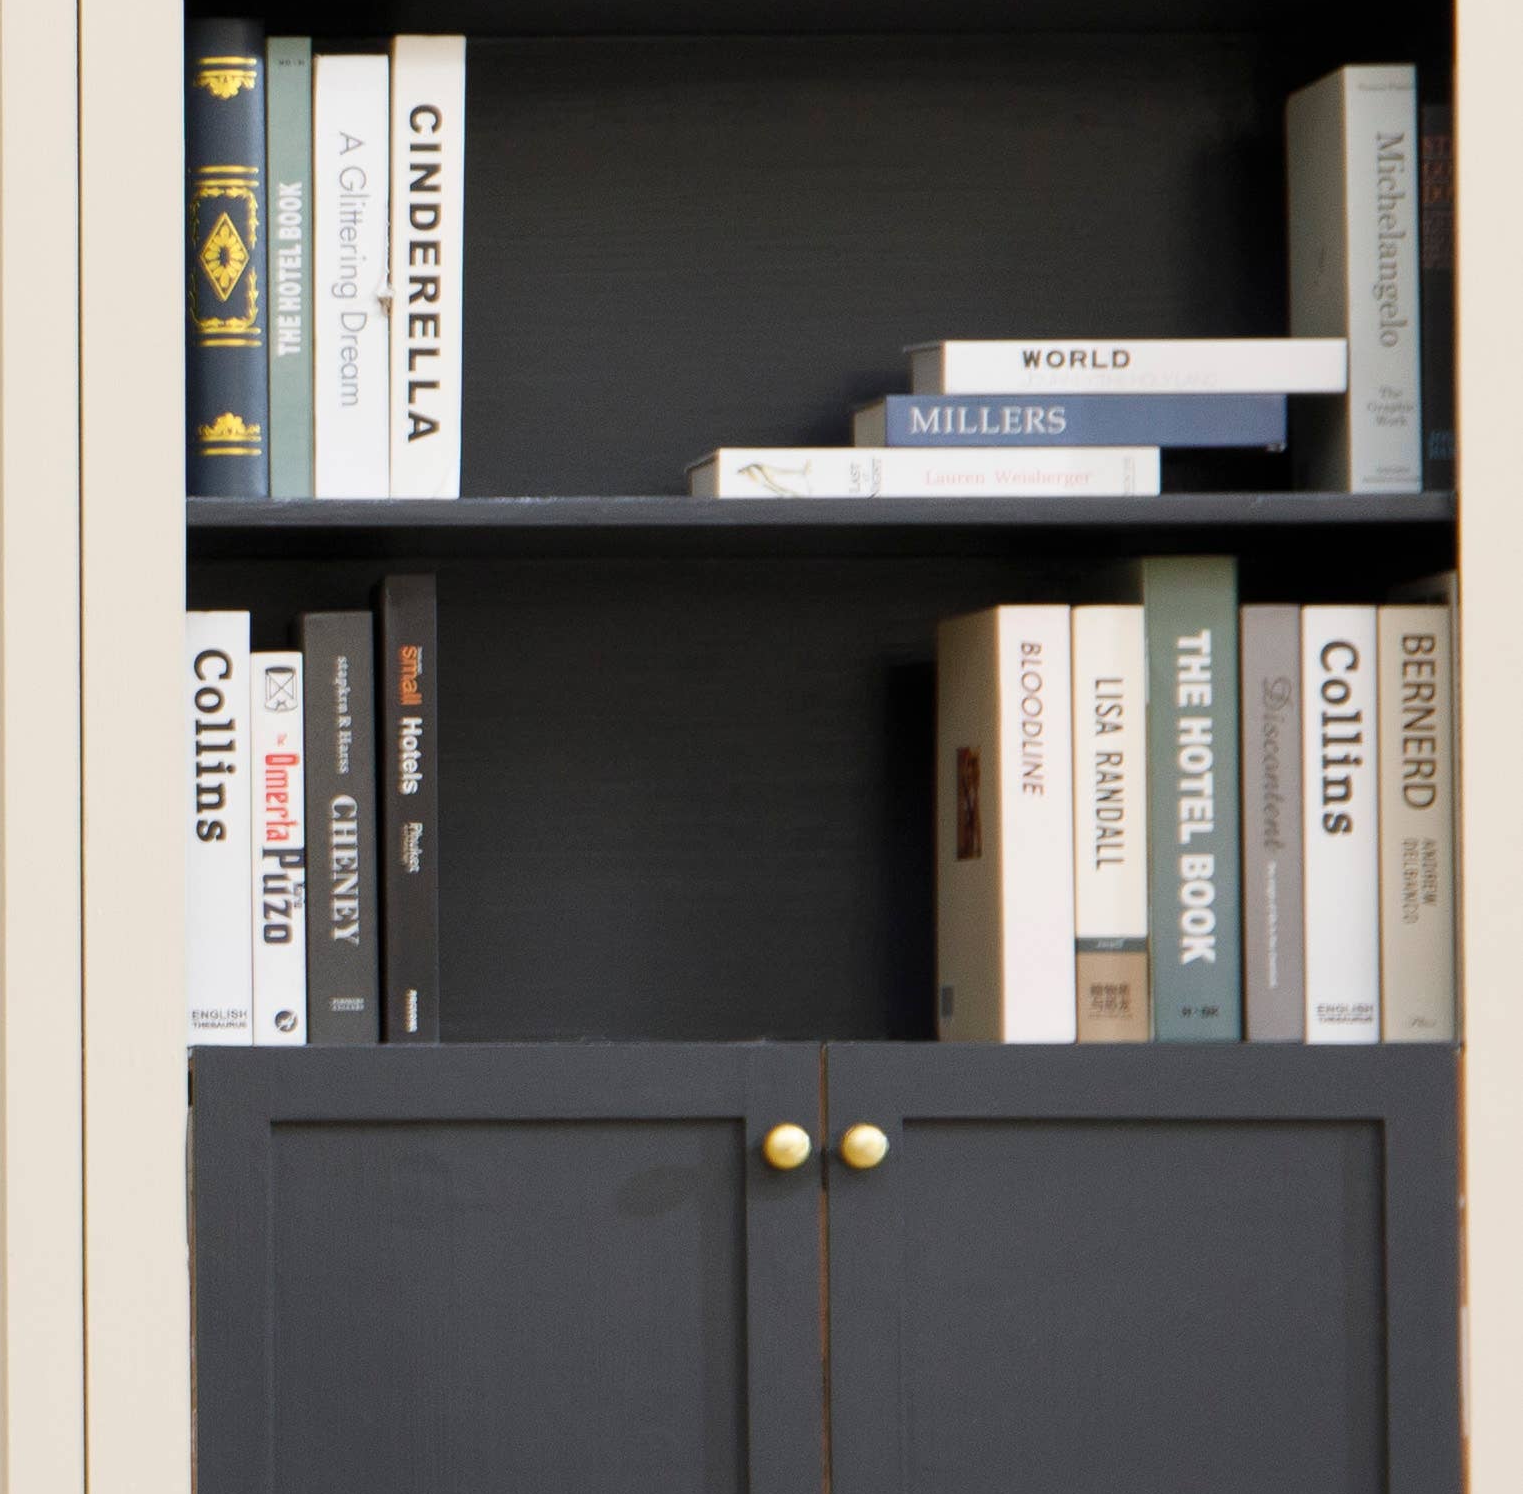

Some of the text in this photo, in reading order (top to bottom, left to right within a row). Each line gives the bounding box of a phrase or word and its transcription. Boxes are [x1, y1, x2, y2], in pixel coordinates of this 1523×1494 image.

[277, 181, 303, 357] THE HOTEL BOOK
[331, 132, 370, 407] A Glittering Dream
[408, 104, 442, 444] CINDERELLA
[1373, 132, 1407, 348] Michelangelo
[910, 407, 1067, 437] MILLERS
[1021, 350, 1131, 370] WORLD
[925, 468, 986, 485] Lauren
[399, 646, 422, 795] small Hotels
[1020, 642, 1044, 795] BLOODLINE
[1176, 629, 1212, 708] THE
[1320, 641, 1363, 836] Collins
[1402, 633, 1436, 809] BERNERD
[193, 648, 236, 843] Collins
[264, 753, 299, 842] Omerta
[1095, 677, 1124, 870] LISA RANDALL
[1178, 717, 1214, 844] HOTEL
[262, 847, 304, 945] Puzo
[331, 795, 359, 946] CHENEY
[1181, 853, 1217, 965] BOOK
